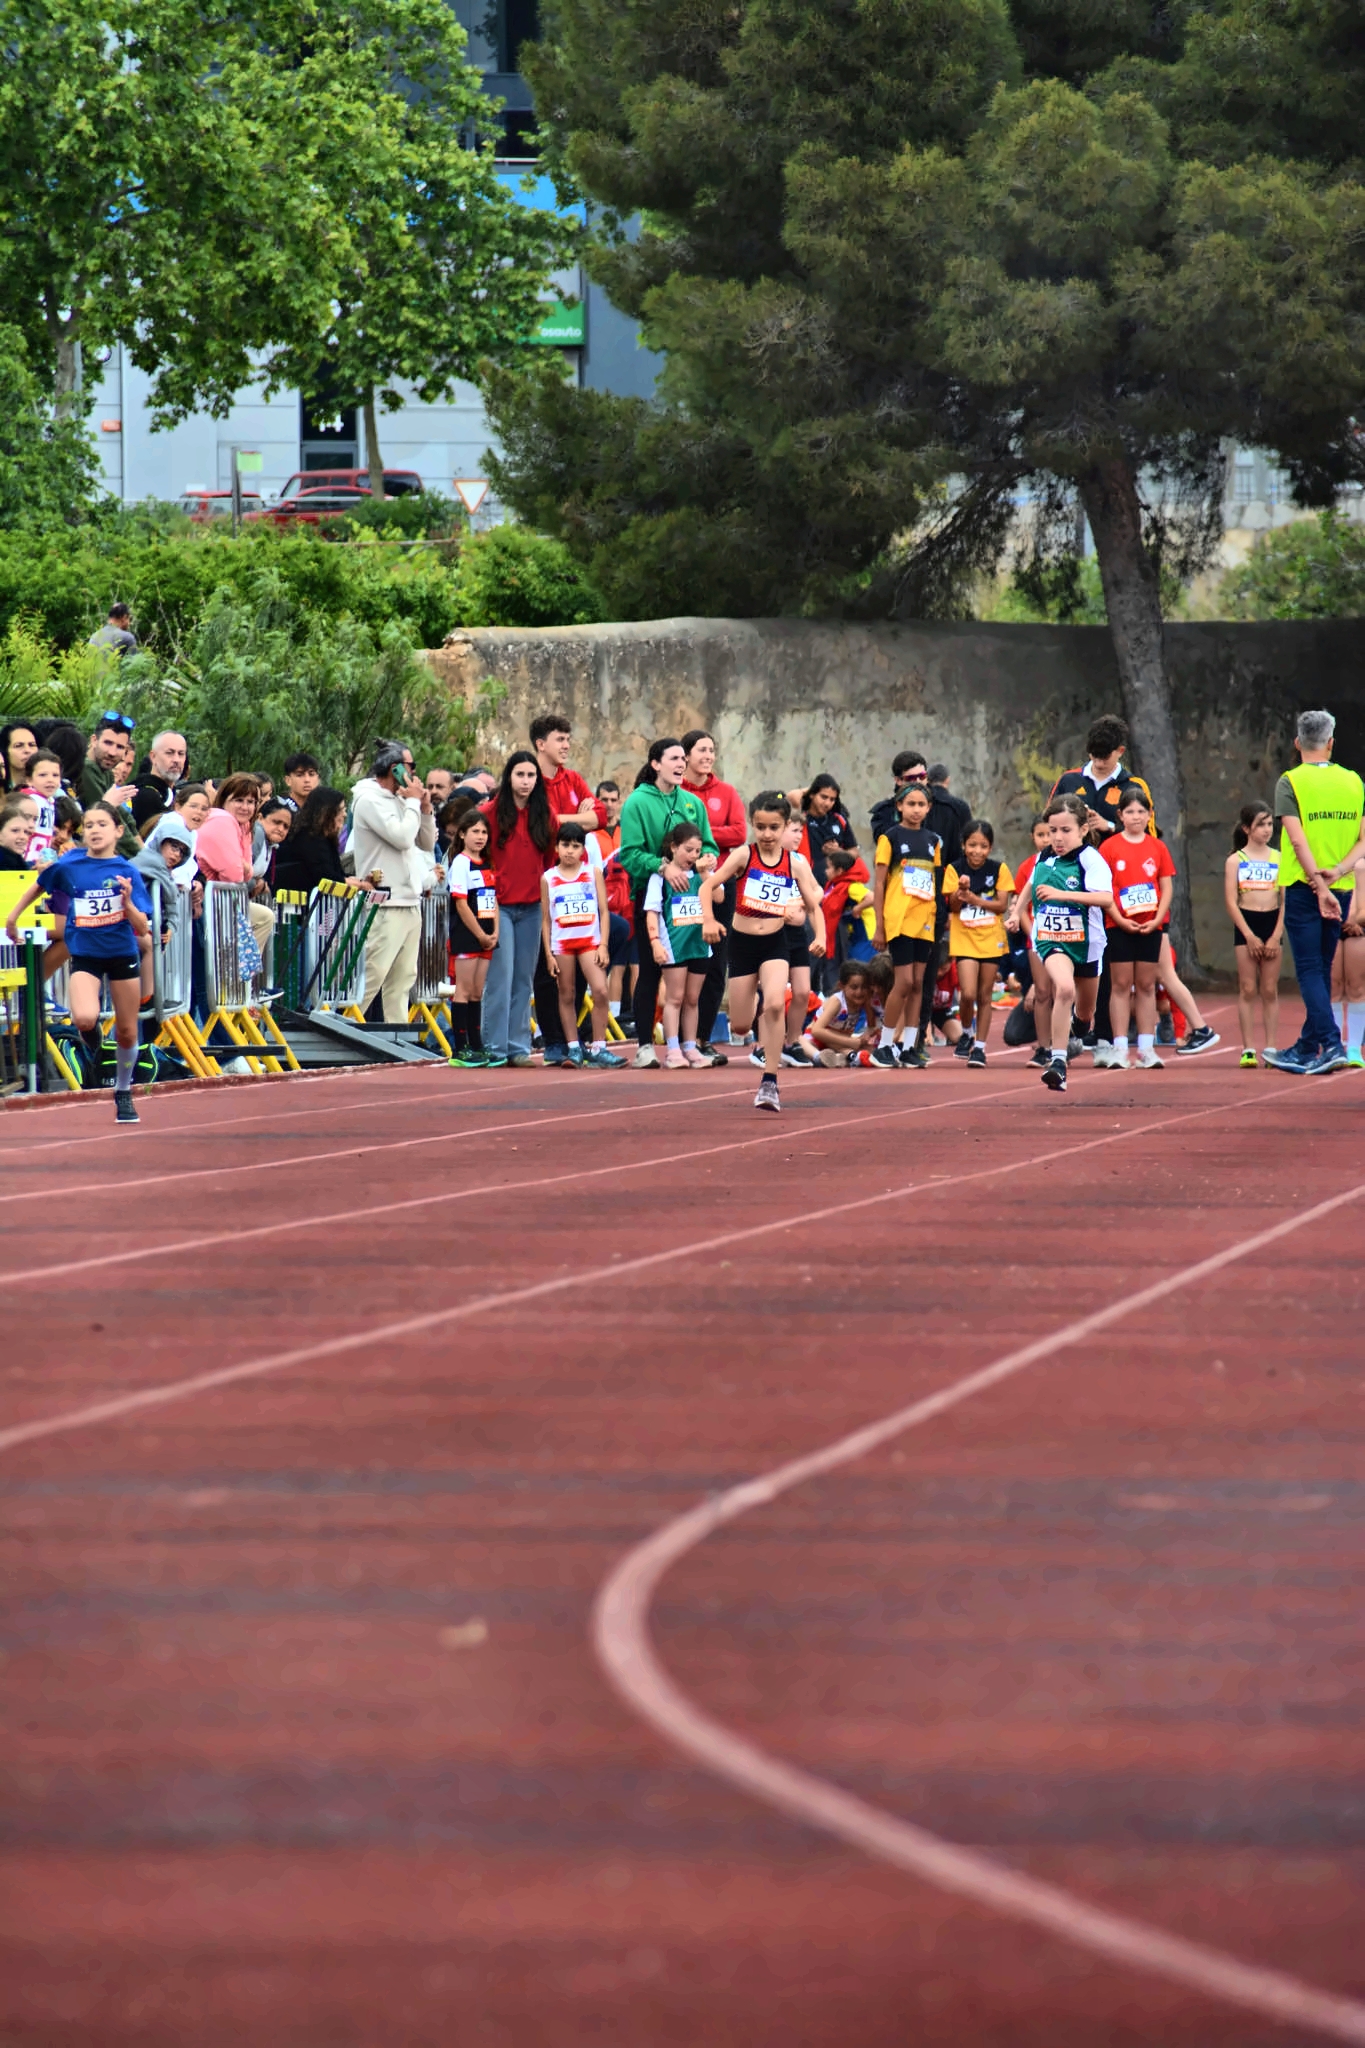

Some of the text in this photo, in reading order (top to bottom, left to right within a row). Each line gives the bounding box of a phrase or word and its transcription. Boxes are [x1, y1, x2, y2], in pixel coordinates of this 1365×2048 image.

[1246, 868, 1272, 880] 296
[759, 884, 781, 903] 59
[1128, 891, 1152, 906] 560
[89, 899, 113, 916] 34
[564, 901, 589, 915] 156
[970, 906, 987, 919] 74
[1043, 915, 1075, 932] 451
